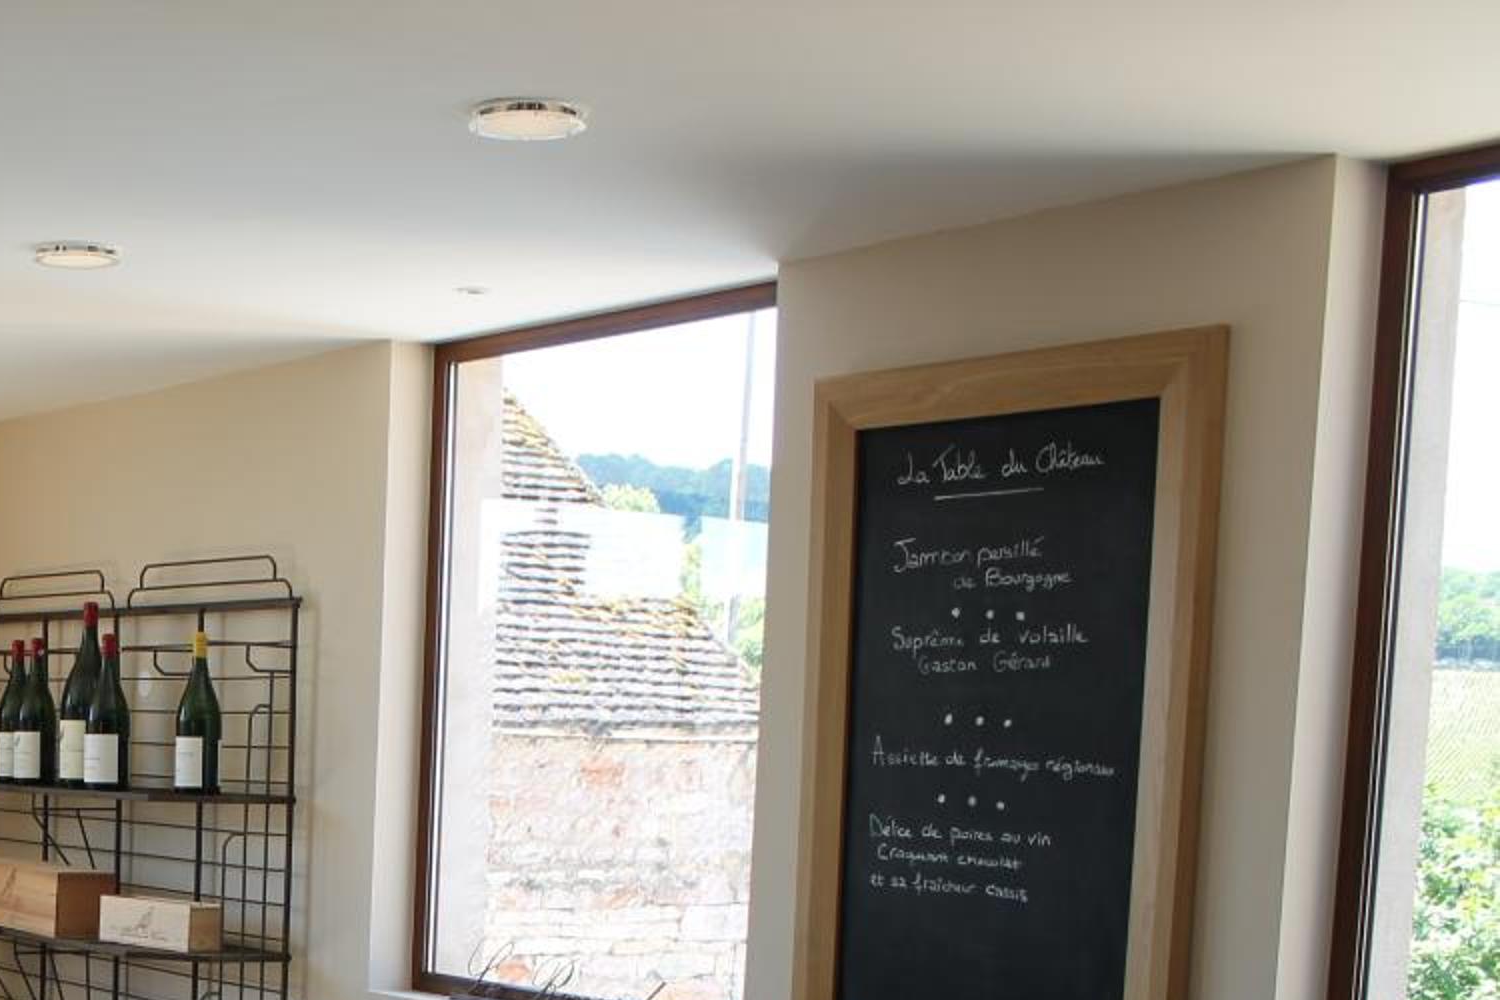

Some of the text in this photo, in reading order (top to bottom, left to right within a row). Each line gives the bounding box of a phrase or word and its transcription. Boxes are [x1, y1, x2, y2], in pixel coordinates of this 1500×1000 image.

[898, 452, 930, 485] La
[933, 445, 986, 481] Table
[1001, 450, 1028, 477] du
[985, 569, 1072, 591] Bourgogne
[980, 624, 1000, 644] de
[945, 751, 966, 766] de
[921, 823, 942, 840] de
[1001, 833, 1021, 845] au
[1027, 831, 1051, 846] vin
[870, 873, 884, 887] et
